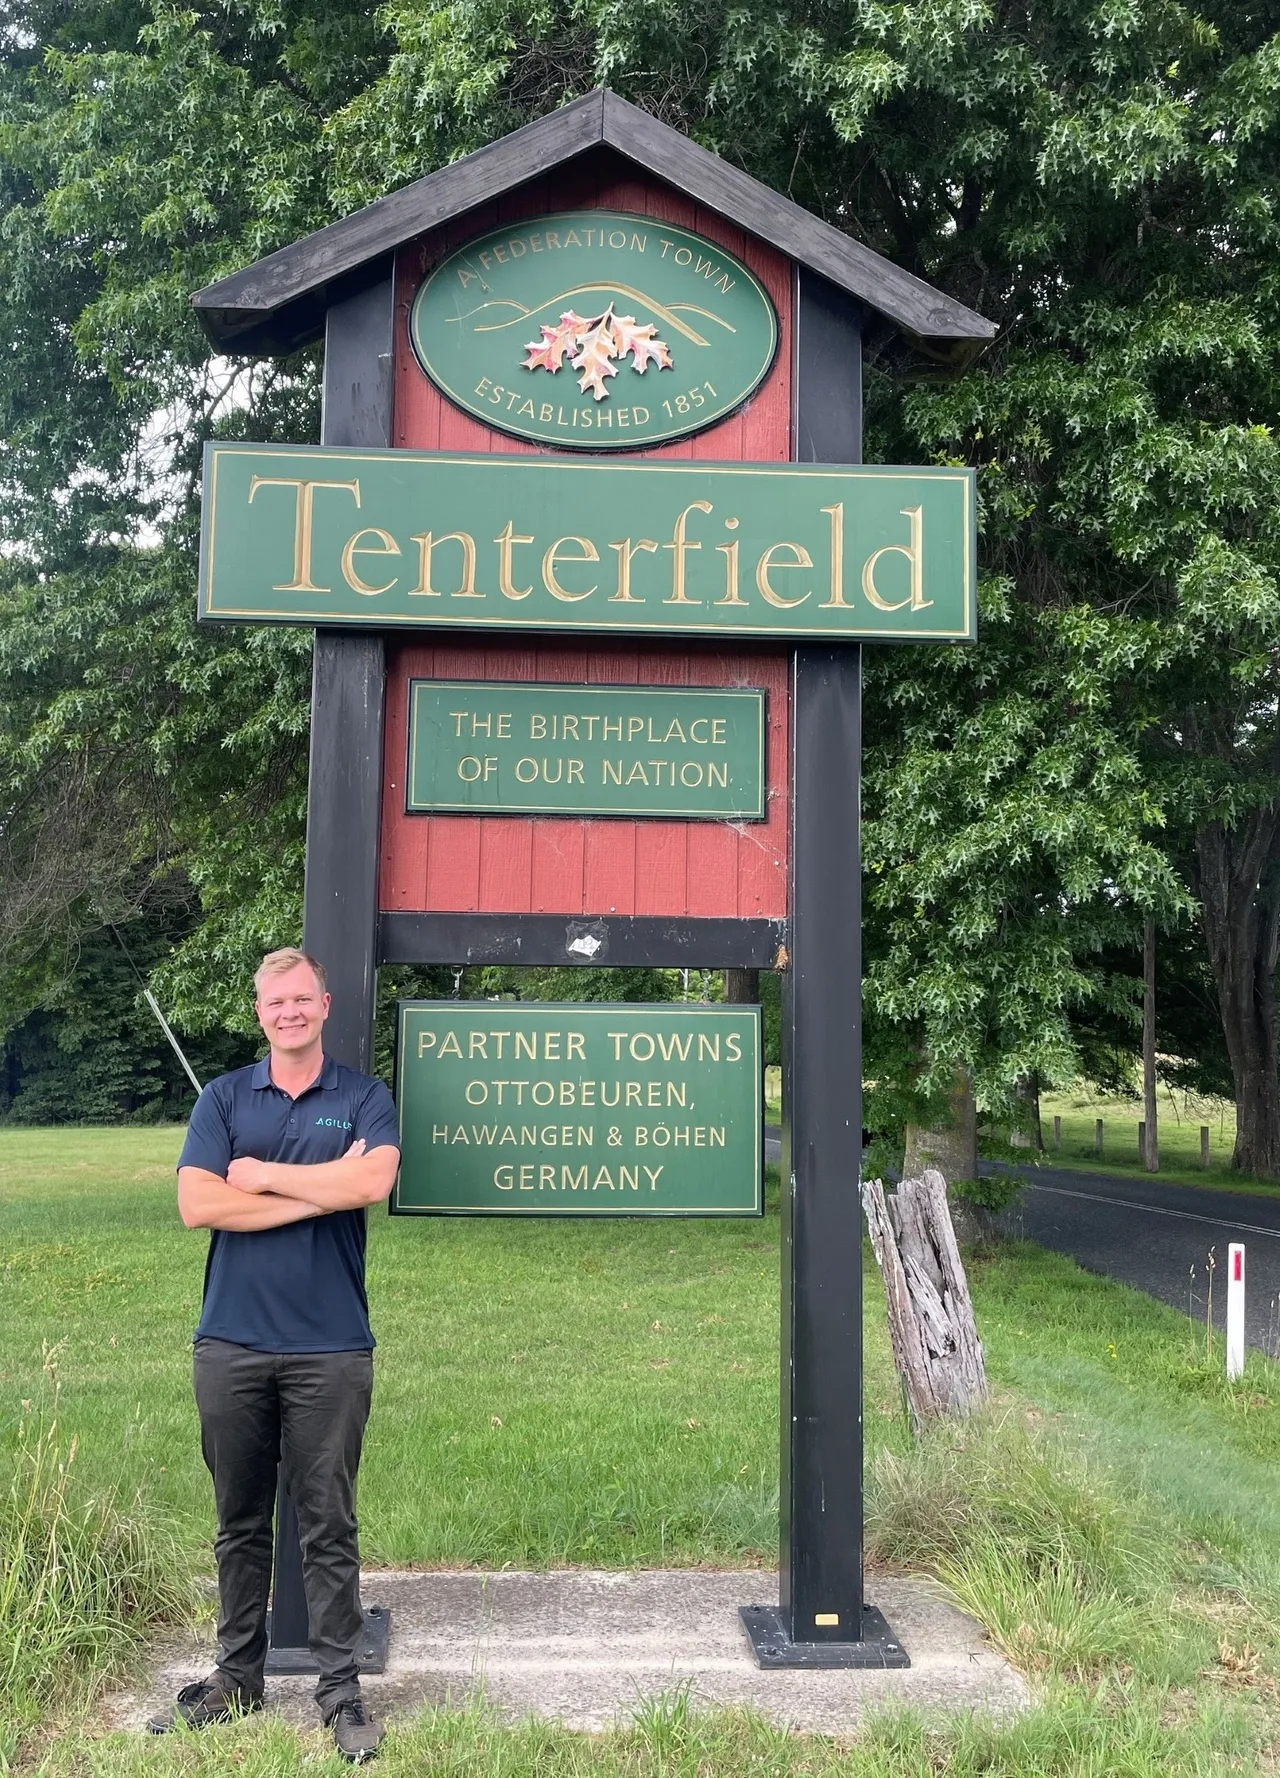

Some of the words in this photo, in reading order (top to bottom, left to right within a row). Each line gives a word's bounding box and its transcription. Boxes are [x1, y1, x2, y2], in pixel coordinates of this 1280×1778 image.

[456, 268, 479, 288] A
[478, 228, 648, 271] FEDERATION
[659, 239, 736, 295] TOWN
[473, 376, 650, 428] ESTABLISHED
[661, 380, 719, 419] 1851
[247, 474, 934, 611] Tenterfield
[449, 711, 512, 739] THE
[529, 713, 727, 744] BIRTHPLACE
[456, 754, 498, 782] OF
[514, 756, 585, 784] OUR
[601, 759, 728, 788] NATION
[417, 1030, 586, 1060] PARTNER
[607, 1032, 743, 1062] TOWNS
[464, 1079, 696, 1110] OTTOBEUREN,
[431, 1123, 594, 1147] HAWANGEN
[606, 1126, 623, 1147] &
[635, 1122, 726, 1147] BÖHEN
[492, 1164, 665, 1191] GERMANY
